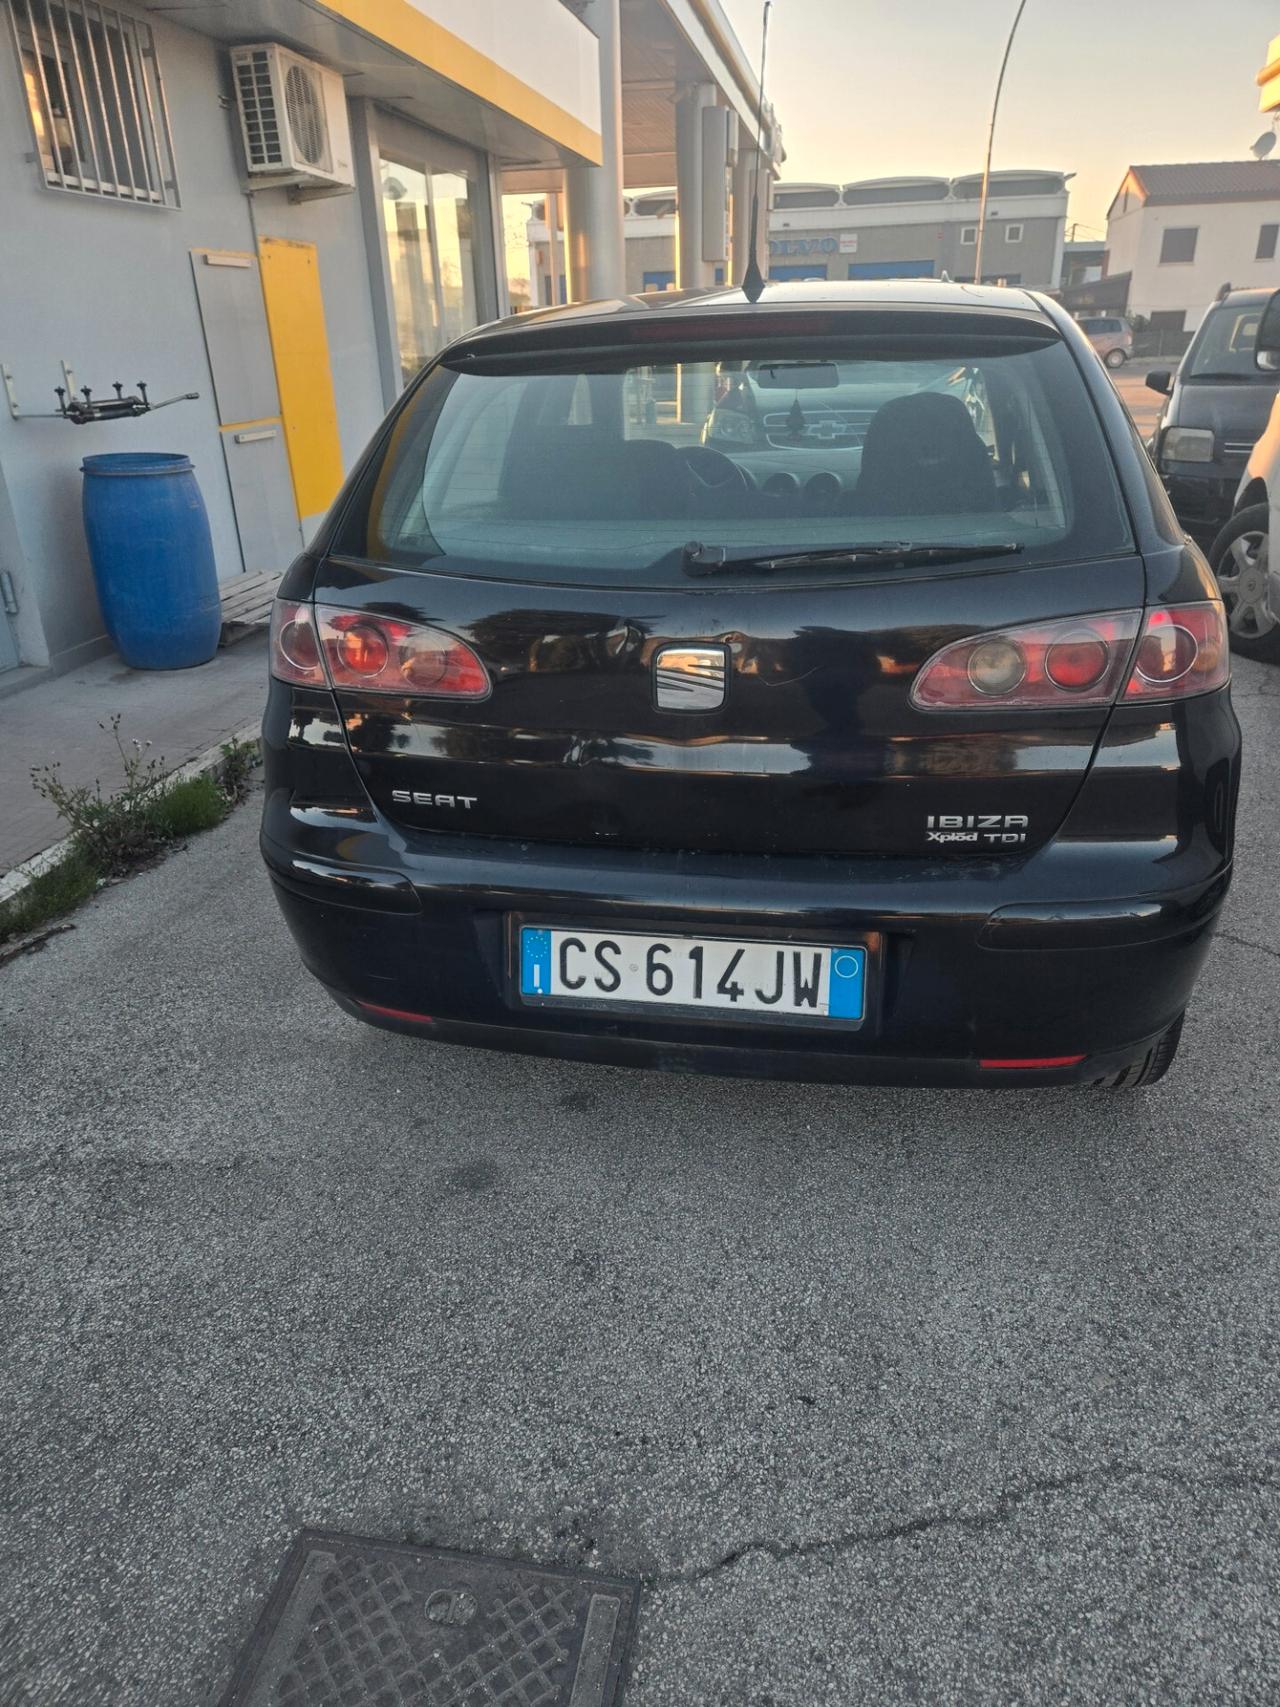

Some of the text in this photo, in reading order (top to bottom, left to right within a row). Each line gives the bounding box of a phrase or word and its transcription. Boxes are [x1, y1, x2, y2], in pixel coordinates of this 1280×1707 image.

[769, 238, 837, 257] OLVO
[391, 790, 478, 809] SEAT
[927, 815, 1029, 828] IBIZA
[983, 833, 1026, 843] TDI
[559, 937, 823, 1009] CS 614 JW
